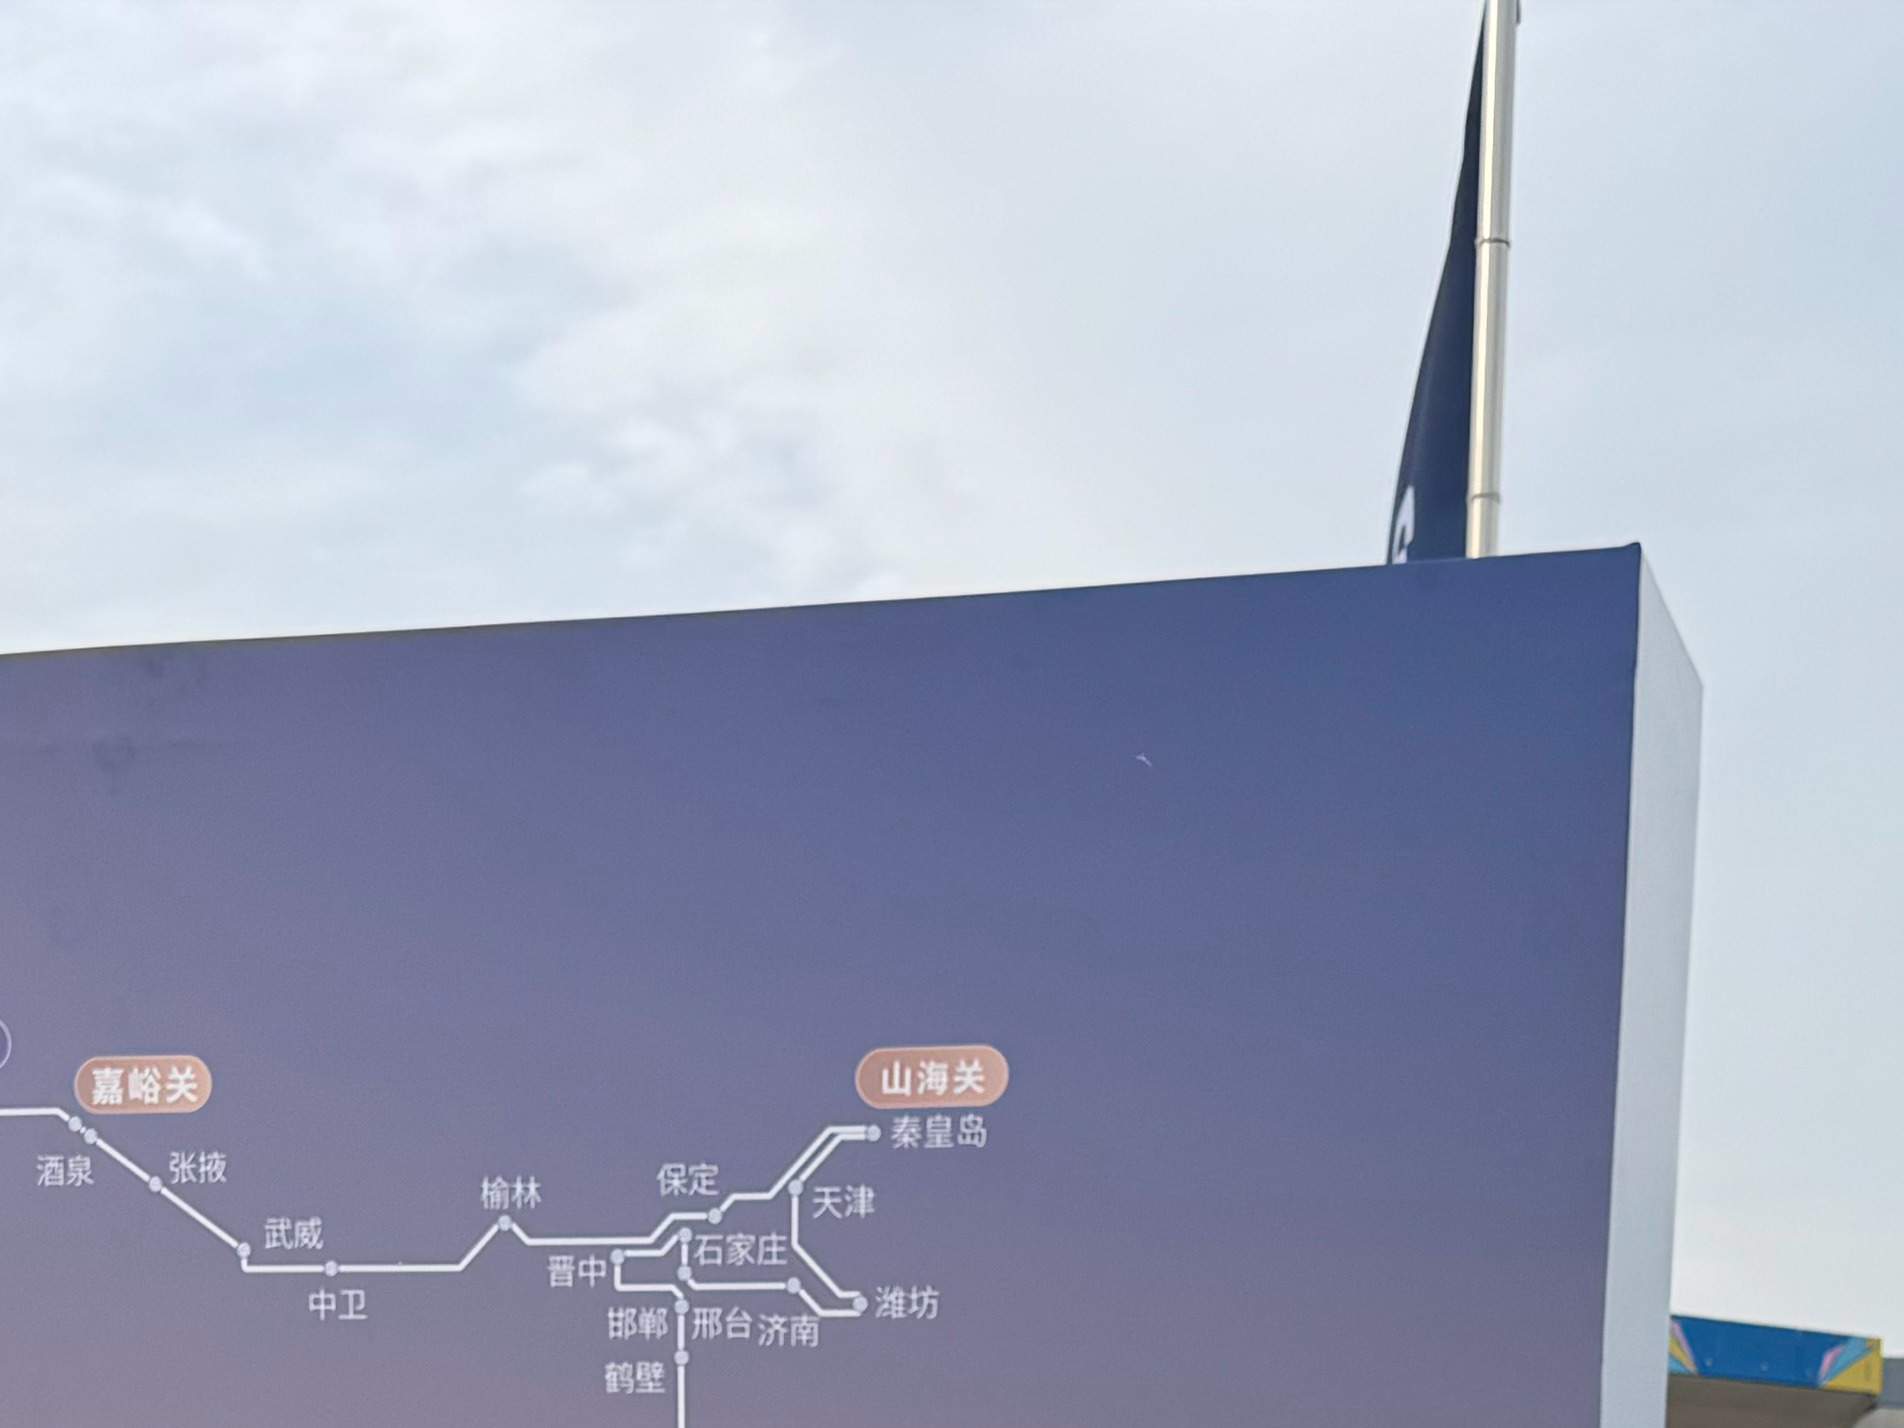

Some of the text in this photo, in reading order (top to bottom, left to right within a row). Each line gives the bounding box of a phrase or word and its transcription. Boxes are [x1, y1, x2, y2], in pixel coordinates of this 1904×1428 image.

[93, 1066, 198, 1104] 嘉峪关
[883, 1059, 984, 1095] 山海关
[892, 1114, 986, 1148] 秦皇岛
[37, 1155, 93, 1186] 酒泉
[170, 1152, 226, 1183] 张掖
[657, 1164, 718, 1195] 保定
[482, 1177, 540, 1208] 榆林
[814, 1185, 874, 1218] 天津
[265, 1218, 323, 1249] 武威
[695, 1234, 787, 1266] 石家庄
[549, 1256, 606, 1287] 晋中
[309, 1289, 367, 1320] 中卫
[876, 1286, 939, 1319] 潍坊
[608, 1308, 667, 1339] 邯郸
[692, 1307, 752, 1339] 邢台
[757, 1315, 819, 1347] 济南
[605, 1362, 664, 1393] 鹤壁
